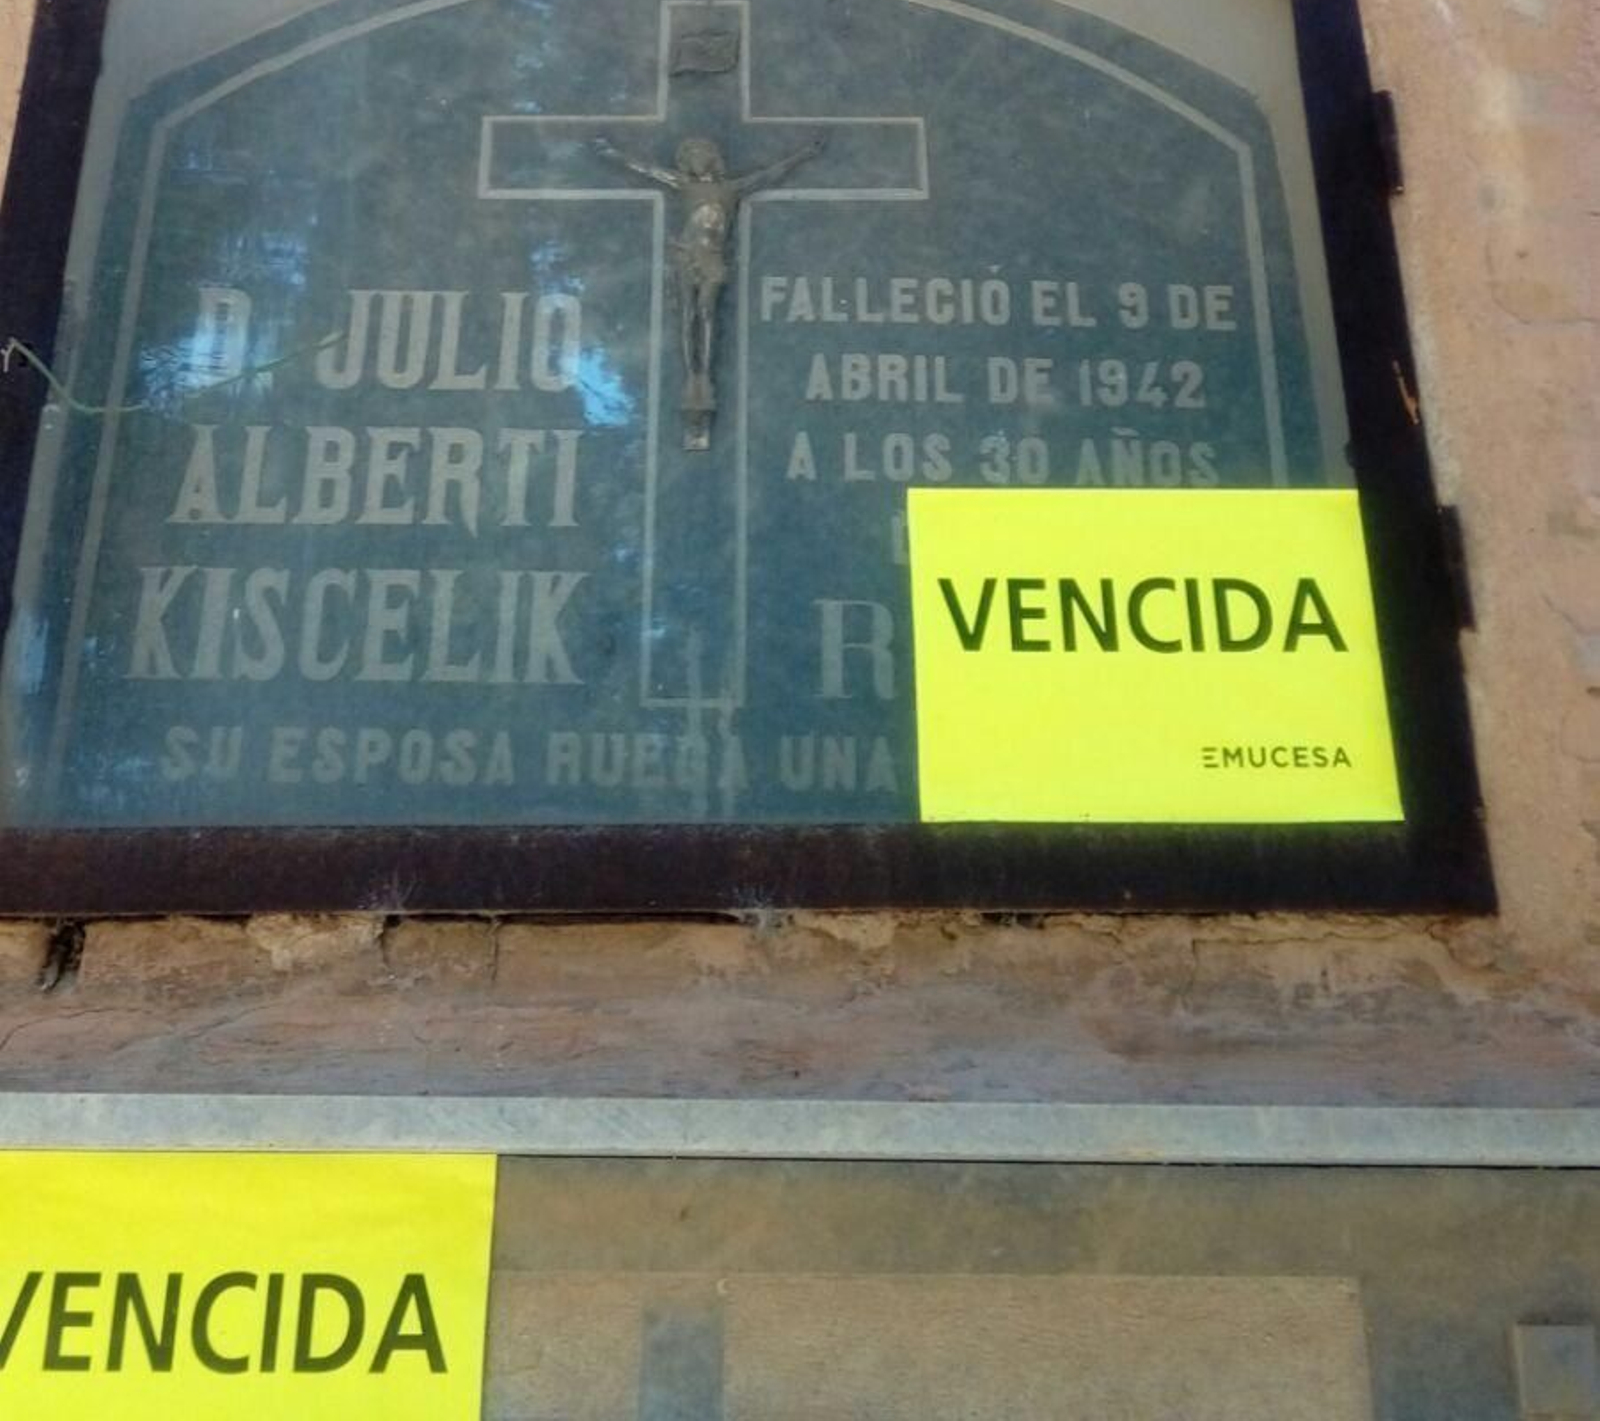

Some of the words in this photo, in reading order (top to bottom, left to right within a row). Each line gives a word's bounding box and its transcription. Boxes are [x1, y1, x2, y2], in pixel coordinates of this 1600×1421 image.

[1030, 280, 1098, 328] EL
[1118, 282, 1150, 330] 9
[1168, 283, 1238, 332] DE
[316, 289, 583, 393] JULIO
[804, 353, 965, 403] ABRIL
[987, 356, 1055, 406] DE
[1078, 358, 1207, 409] 1942
[166, 424, 585, 537] ALBERTI
[786, 430, 818, 480] A
[844, 432, 953, 481] LOS
[978, 435, 1050, 485] 30
[1074, 426, 1222, 487] AÑOS
[124, 565, 589, 686] KISCELIK
[937, 577, 1350, 655] VENCIDA
[160, 726, 242, 782] SU
[266, 726, 516, 787] ESPOSA
[777, 732, 897, 792] UNA
[1200, 745, 1353, 770] EMUCESA
